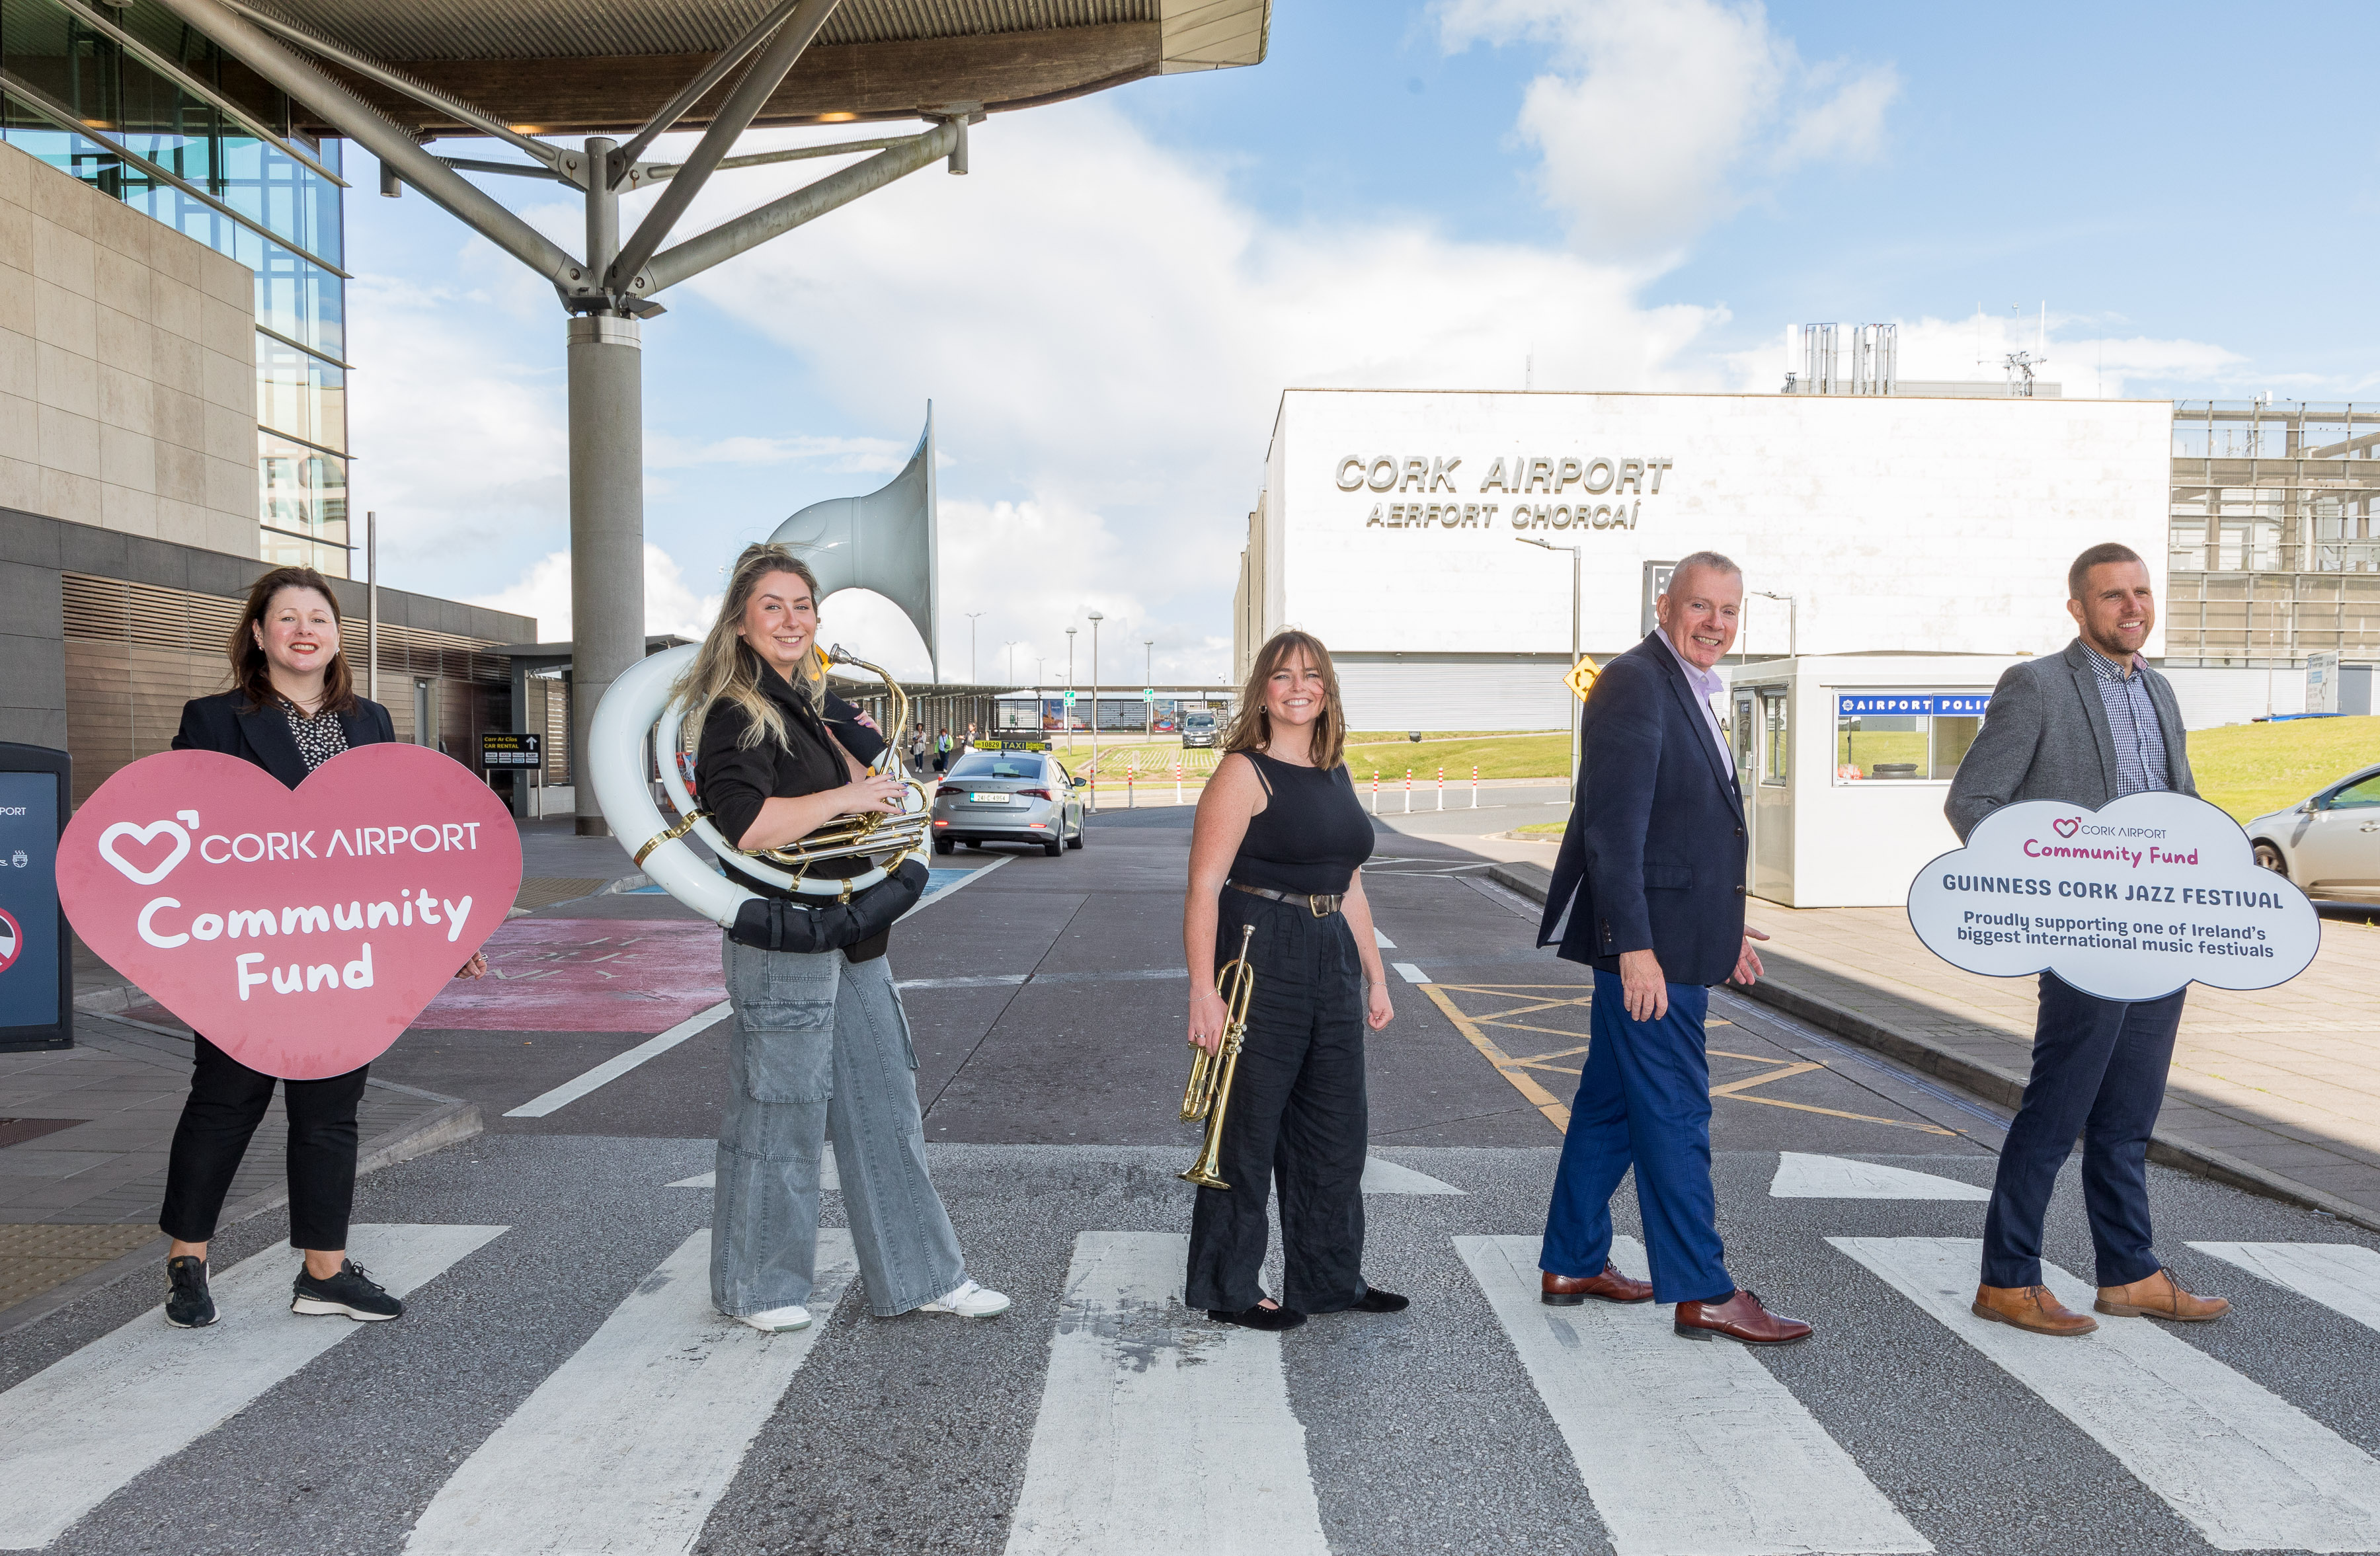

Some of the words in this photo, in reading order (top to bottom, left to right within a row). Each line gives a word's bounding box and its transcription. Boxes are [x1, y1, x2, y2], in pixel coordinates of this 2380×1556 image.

[1335, 454, 1462, 493] CORK
[1480, 455, 1673, 495] AIRPORT
[1366, 502, 1498, 528] AERFORT
[1511, 499, 1642, 530] CHORCAÍ
[1856, 700, 1931, 710] AIRPORT
[1942, 700, 1990, 710] POLI
[1003, 741, 1025, 750] TAXI
[0, 807, 26, 816] PORT
[200, 830, 318, 864] CORK
[325, 822, 481, 858] AIRPORT
[2081, 825, 2117, 836] CORK
[2118, 827, 2166, 839] AIRPORT
[2023, 838, 2143, 869] Community
[2149, 846, 2199, 866] Fund
[1942, 874, 2051, 896] GUINNESS
[2058, 880, 2119, 900] CORK
[2125, 884, 2176, 904] JAZZ
[2182, 888, 2284, 910] FESTIVAL
[137, 888, 473, 949] Community
[1964, 910, 2030, 933] Proudly
[2035, 917, 2129, 937] supporting
[2133, 923, 2164, 935] one
[2168, 922, 2186, 936] of
[1958, 927, 2022, 946] biggest
[2026, 930, 2137, 951] international
[2142, 939, 2194, 954] music
[2198, 941, 2274, 958] festivals
[235, 941, 375, 1001] Fund
